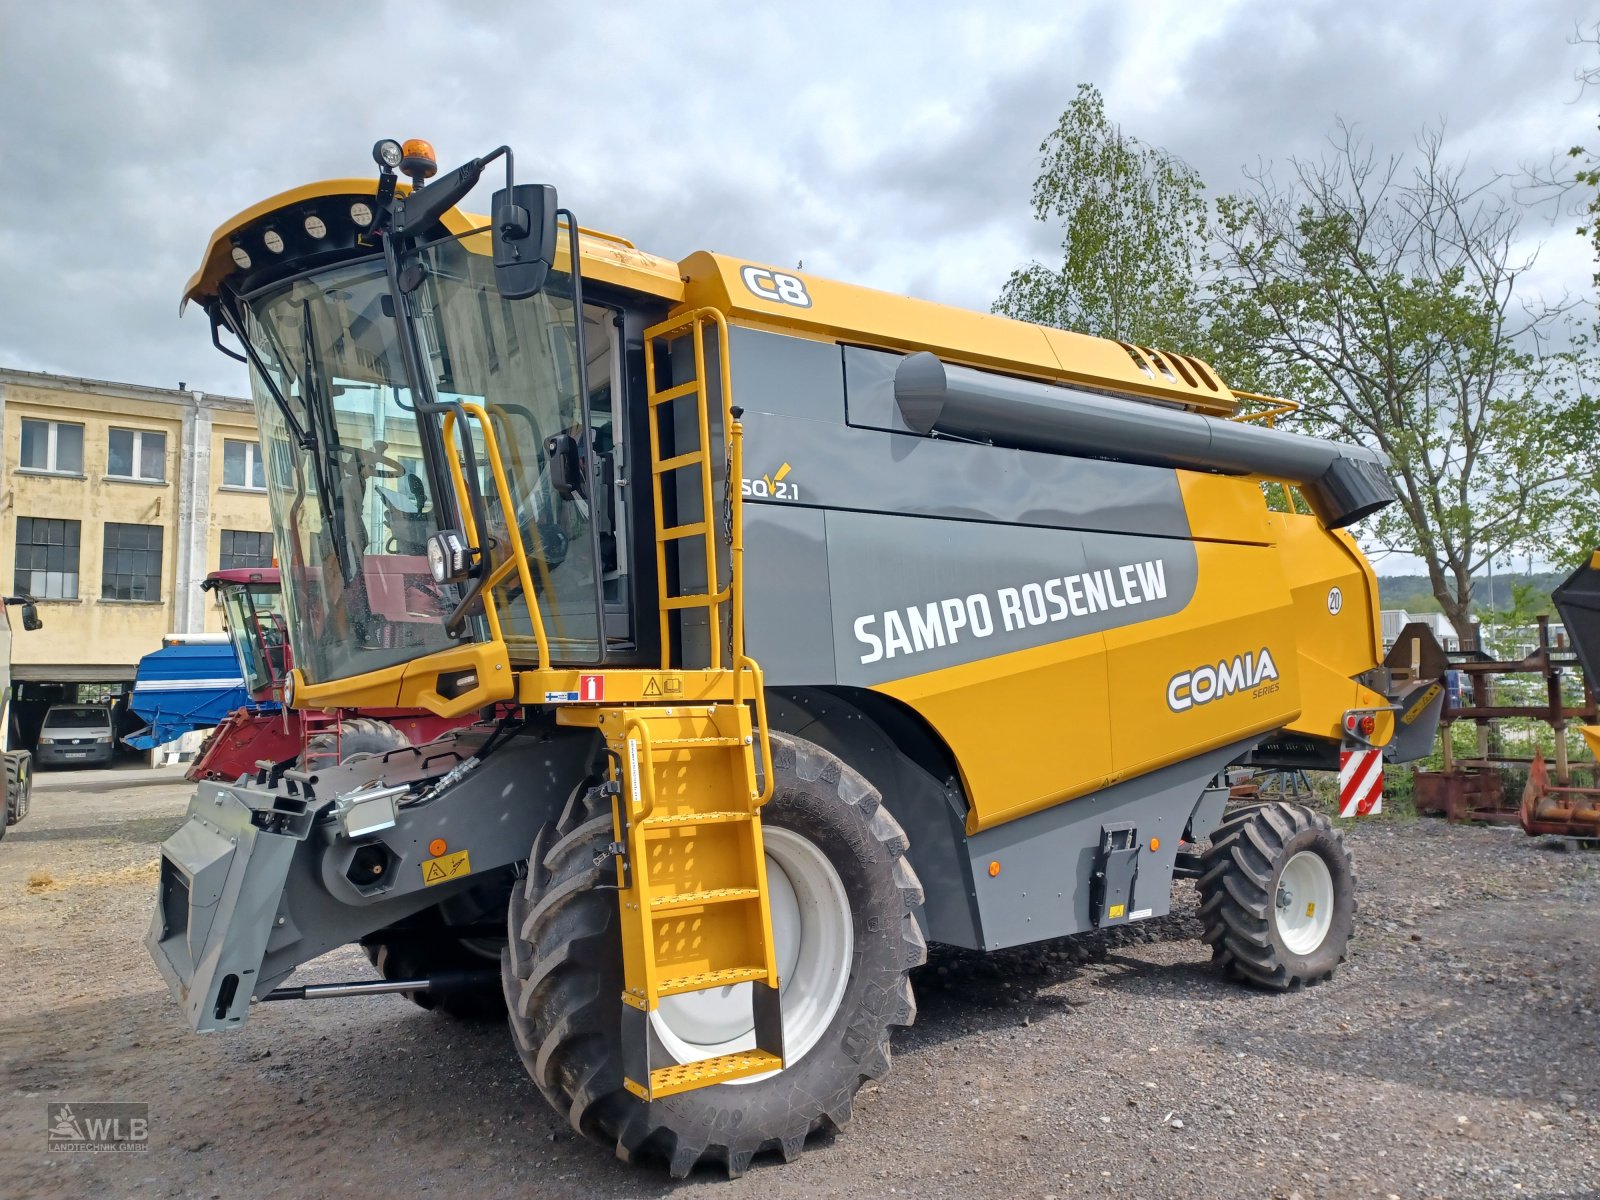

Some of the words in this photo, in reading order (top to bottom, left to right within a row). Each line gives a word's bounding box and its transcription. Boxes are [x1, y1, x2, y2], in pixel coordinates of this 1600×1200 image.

[740, 265, 812, 308] C8
[775, 482, 799, 501] 2.1
[853, 593, 994, 665] SAMPO
[997, 559, 1168, 632] ROSENLEW
[1330, 592, 1340, 610] 20
[1166, 646, 1280, 713] COMIA
[1252, 683, 1280, 699] SERIES
